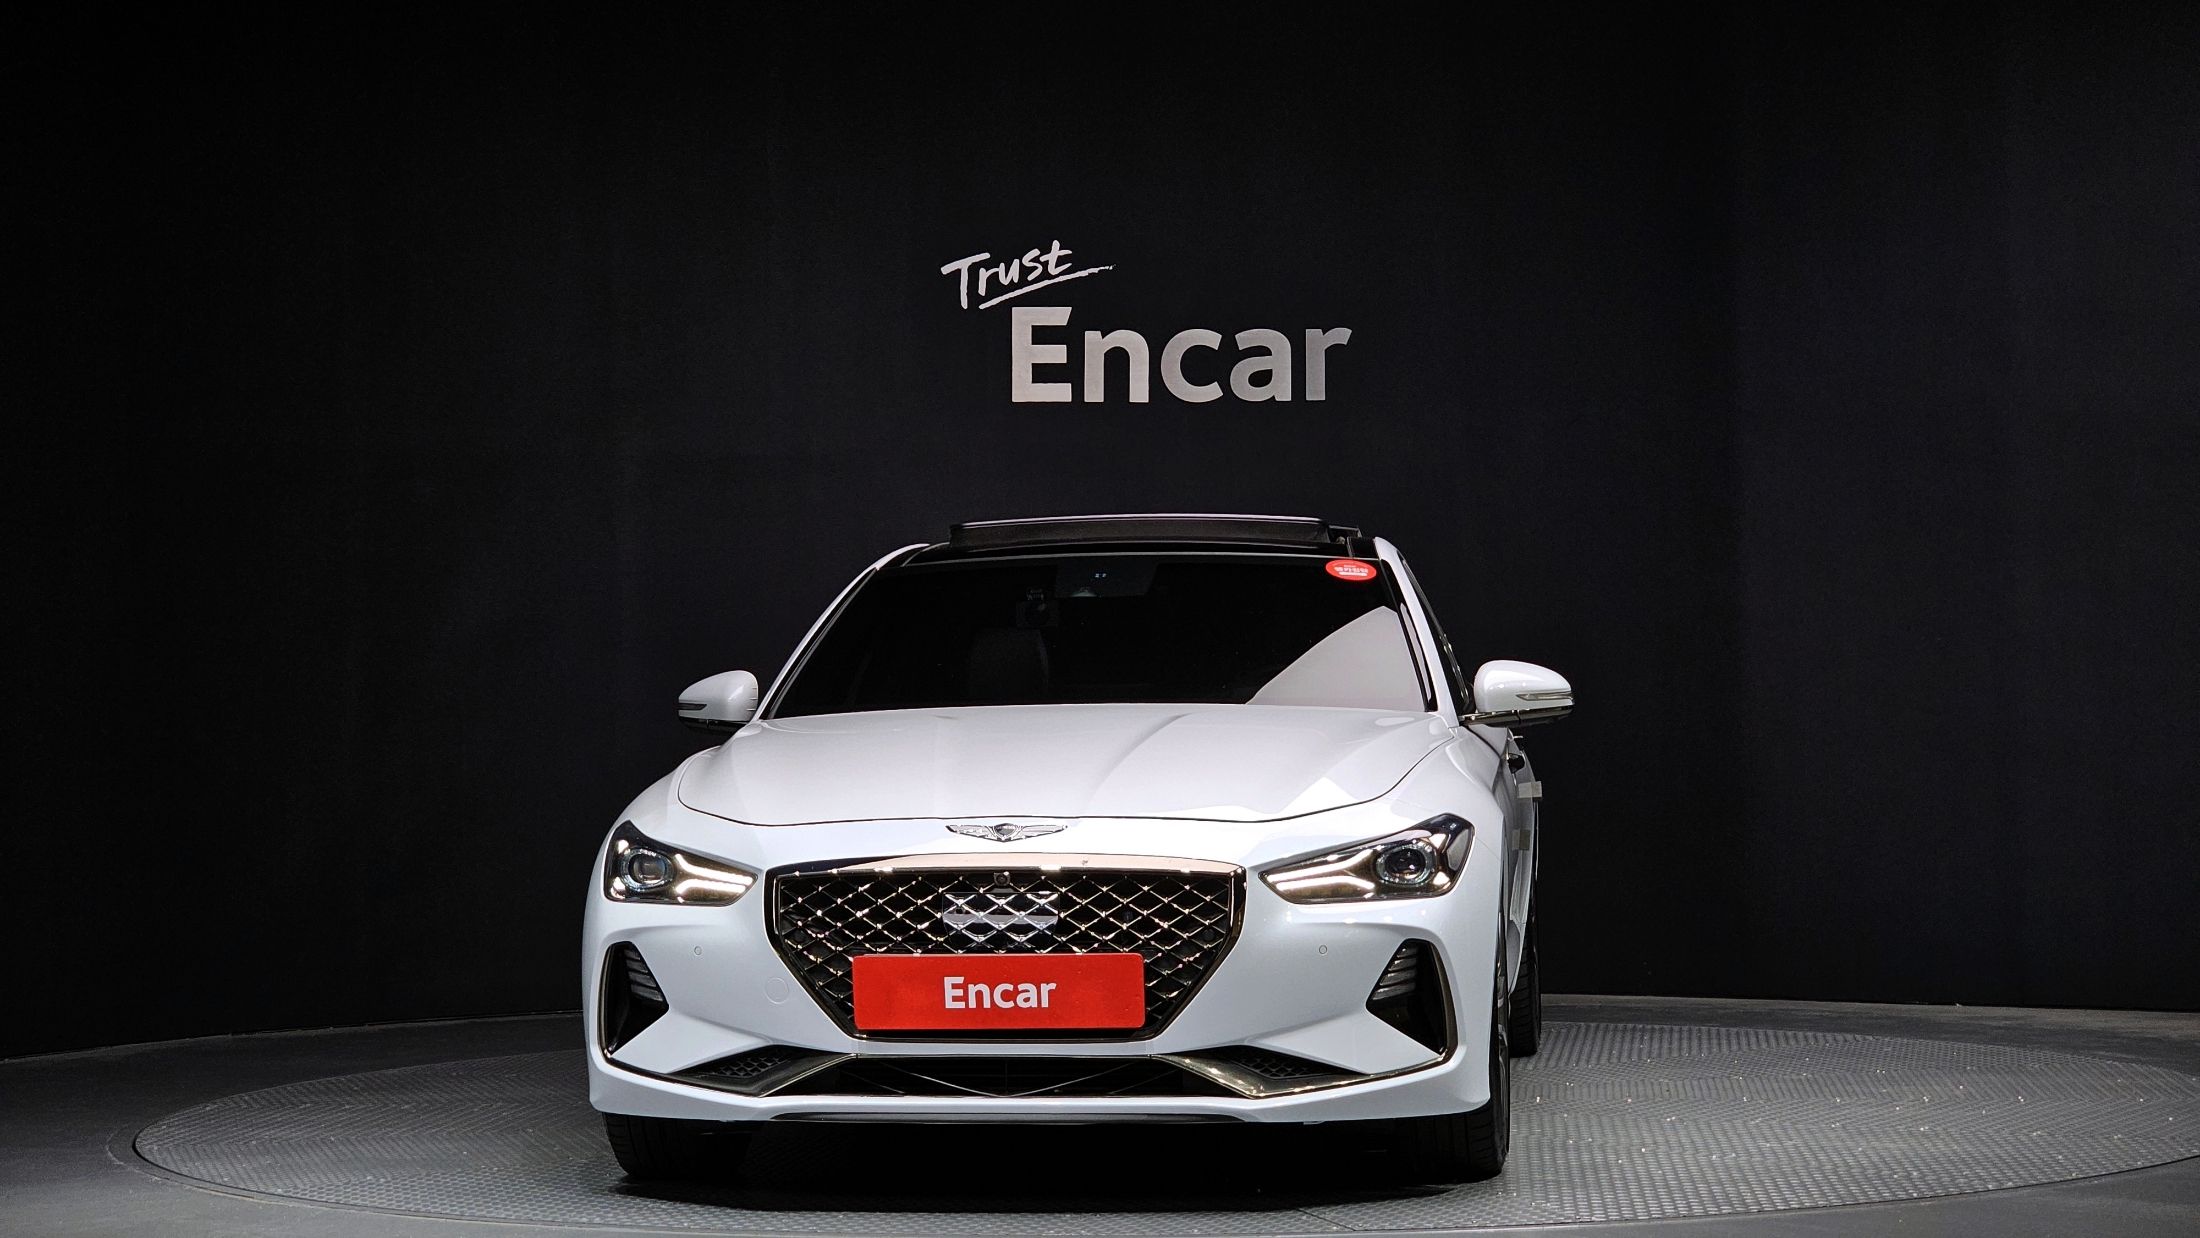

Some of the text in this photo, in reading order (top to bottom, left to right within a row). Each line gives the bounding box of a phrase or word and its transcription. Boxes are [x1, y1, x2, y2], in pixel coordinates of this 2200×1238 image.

[941, 240, 1074, 309] Trust
[1012, 306, 1352, 403] Encar
[943, 976, 1056, 1009] Encar
